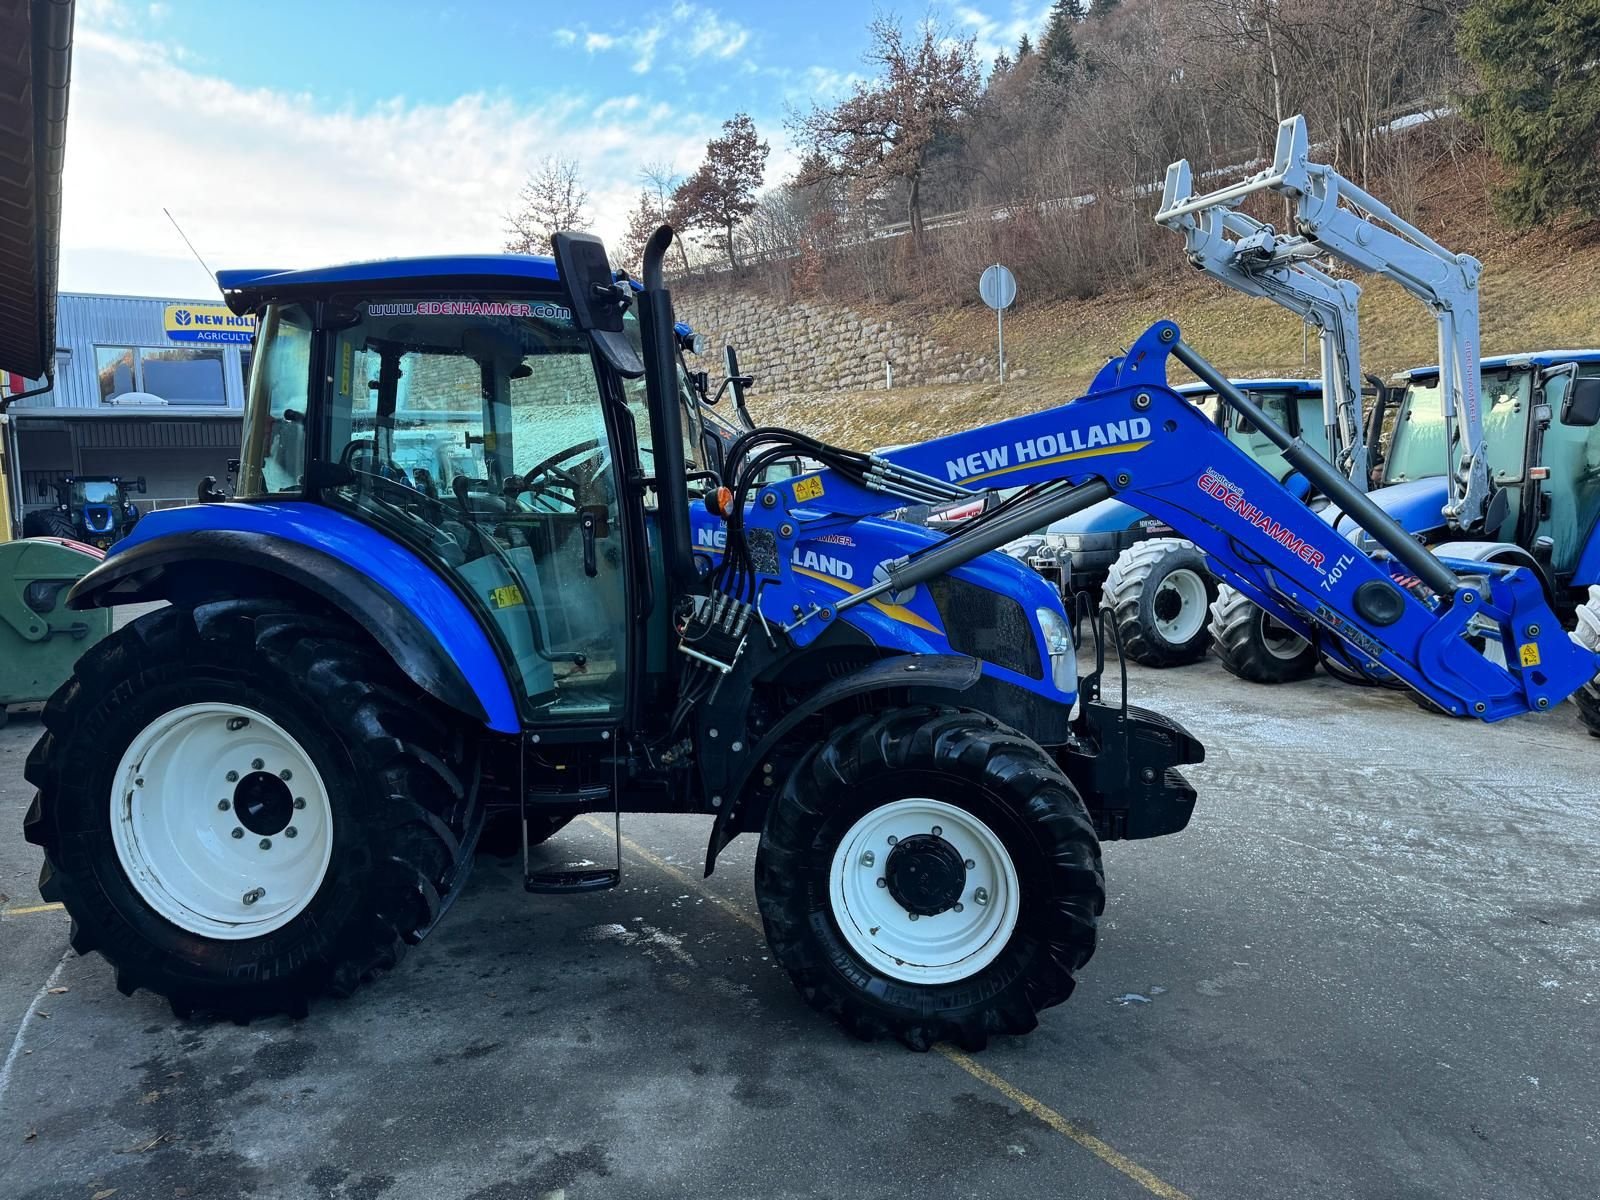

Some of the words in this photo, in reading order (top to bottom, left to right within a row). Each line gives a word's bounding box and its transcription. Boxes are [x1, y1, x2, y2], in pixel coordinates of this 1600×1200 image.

[194, 314, 223, 325] NEW
[226, 316, 255, 327] HOLL
[369, 302, 571, 320] www.EIDENHAMMER.com
[197, 331, 253, 341] AGRICULTU
[946, 445, 1008, 482] NEW
[1015, 417, 1151, 463] HOLLAND
[1197, 473, 1326, 569] EIDENHAMMER
[698, 528, 728, 549] NE
[791, 547, 853, 580] LAND
[1320, 554, 1356, 592] 740TL
